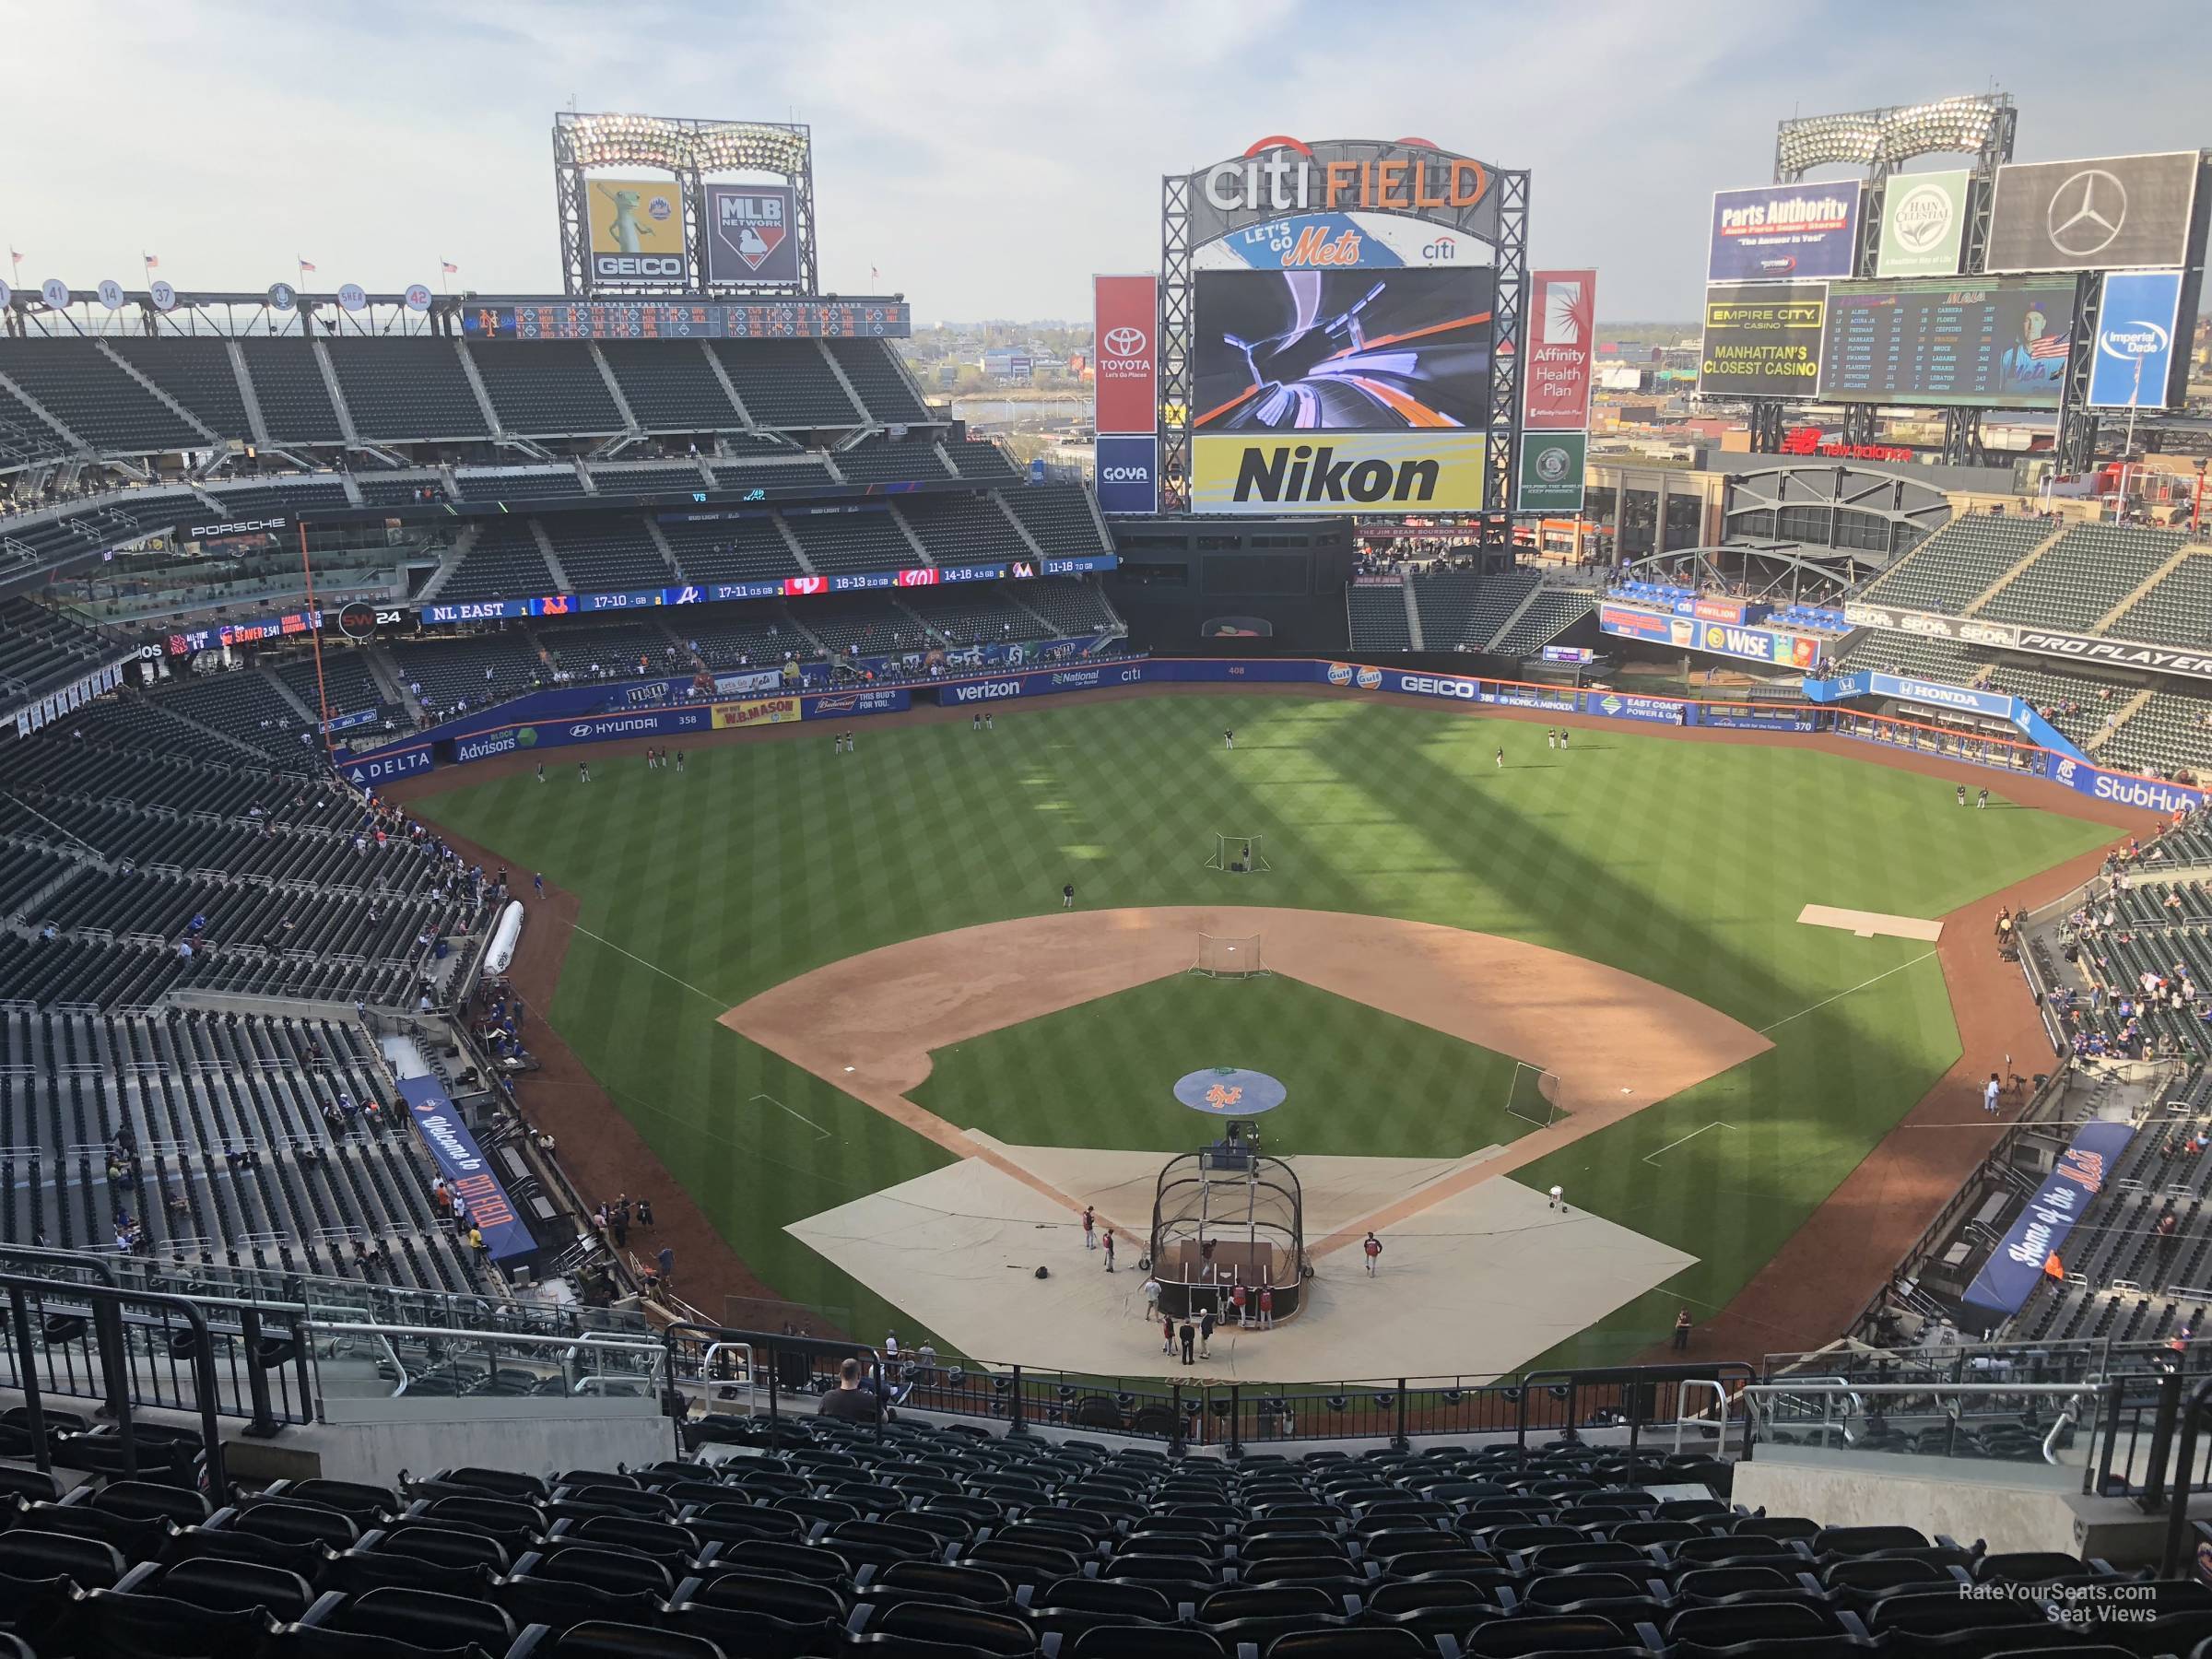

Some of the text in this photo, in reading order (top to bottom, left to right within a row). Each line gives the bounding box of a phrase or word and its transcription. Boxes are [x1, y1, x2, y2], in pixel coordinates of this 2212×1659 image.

[1206, 147, 1487, 211] citi FIELD
[722, 198, 782, 219] MLB
[1722, 197, 1848, 228] Parts Authority
[1911, 201, 1939, 212] HAIN
[722, 218, 782, 228] NETWORK
[1244, 221, 1291, 246] LET'S
[1270, 236, 1293, 253] GO
[1282, 226, 1362, 267] Mets
[1422, 240, 1455, 261] citi
[598, 257, 680, 276] GEICO
[49, 287, 64, 300] 41
[104, 288, 118, 300] 14
[156, 288, 171, 302] 37
[410, 291, 427, 304] 42
[1713, 310, 1773, 321] EMPIRE
[2110, 331, 2155, 346] Imperial
[1714, 346, 1807, 359] MANHATTAN'S
[2128, 342, 2159, 354] Dade
[1534, 349, 1585, 364] Affinity
[1100, 360, 1150, 371] TOYOTA
[1704, 360, 1817, 376] CLOSEST CASINO
[1536, 368, 1581, 381] Health
[1544, 383, 1571, 396] Plan
[1822, 443, 1913, 461] new balance
[1102, 467, 1148, 480] GOYA
[1233, 446, 1441, 502] Nikon
[693, 493, 707, 502] VS
[192, 518, 287, 537] PORSCHE
[433, 607, 457, 620] NL
[460, 603, 504, 618] EAST
[521, 607, 528, 616] 1
[594, 595, 627, 607] 17-10
[636, 596, 646, 605] GB
[655, 596, 662, 605] 2
[719, 586, 747, 598] 17-11
[750, 588, 760, 596] 0.5
[762, 587, 773, 595] GB
[778, 587, 784, 595] 3
[836, 577, 865, 589] 16-13
[892, 577, 899, 586] 4
[945, 569, 971, 581] 14-16
[1049, 561, 1073, 572] 11-18
[1677, 601, 1736, 619] citi PAVILION
[344, 611, 401, 627] SW 24
[186, 631, 209, 641] ALL-TIME
[235, 627, 264, 642] SEAVER
[1726, 629, 1771, 657] WISE
[2020, 634, 2088, 653] PRO
[1062, 670, 1099, 683] National
[1121, 667, 1141, 681] citi
[1229, 666, 1244, 675] 408
[1328, 669, 1351, 682] Gulf
[1358, 673, 1381, 685] Gulf
[876, 690, 895, 700] BUD'S
[956, 680, 1020, 700] verizon
[1401, 676, 1474, 699] GEICO
[1479, 694, 1494, 702] 380
[1914, 686, 1979, 706] HONDA
[820, 700, 855, 710] Budweiser
[876, 700, 890, 708] YOU.
[1509, 697, 1574, 712] KONICA MINOLTA
[1628, 699, 1684, 711] EAST COAST
[678, 715, 697, 724] 358
[1627, 708, 1657, 717] POWER
[596, 717, 658, 734] HYUNDAI
[1794, 723, 1812, 731] 370
[459, 737, 515, 761] Advisors
[370, 752, 430, 778] DELTA
[2094, 775, 2196, 814] StubHub
[421, 1115, 482, 1171] Welcome to
[456, 1174, 515, 1229] CITI FIELD
[2007, 1148, 2103, 1267] Home of the Mets
